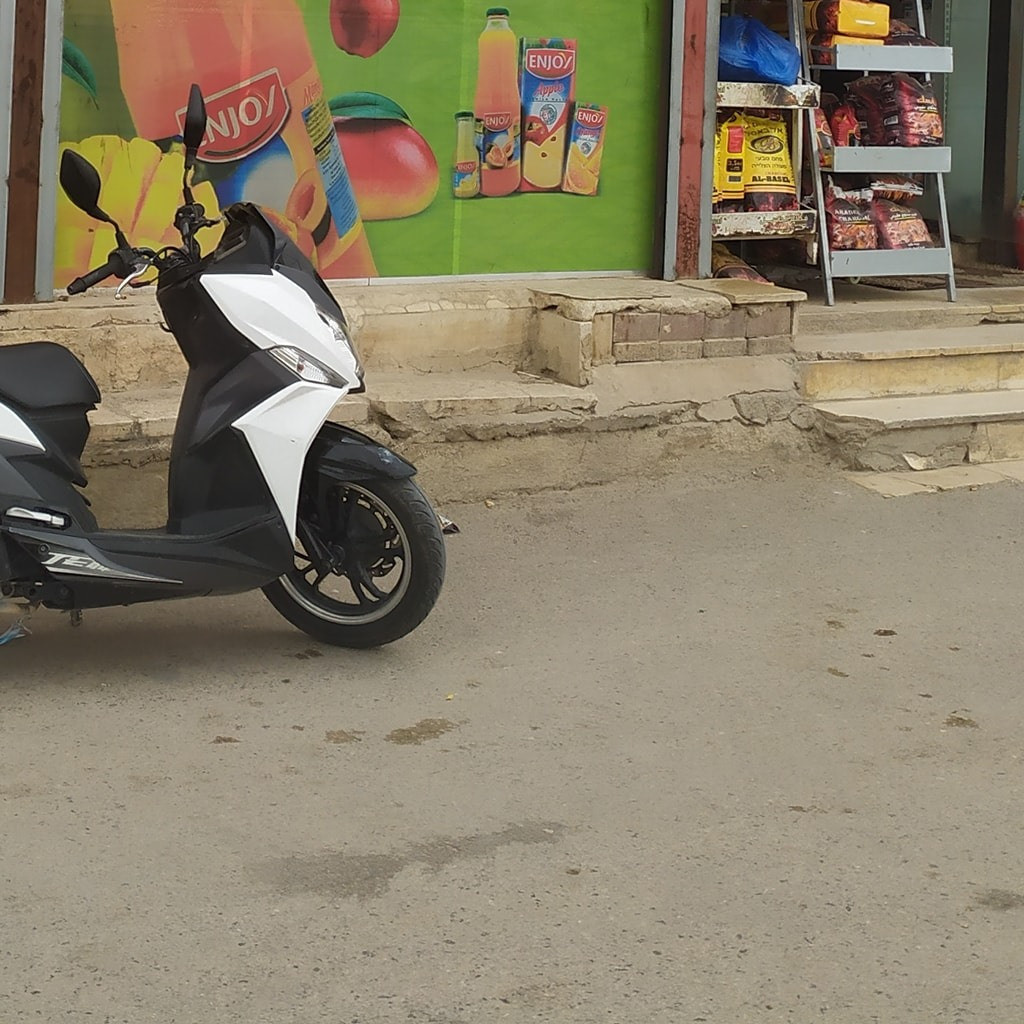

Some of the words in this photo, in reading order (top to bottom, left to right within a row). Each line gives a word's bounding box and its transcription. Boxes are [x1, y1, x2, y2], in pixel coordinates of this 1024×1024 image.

[528, 53, 573, 70] ENJOY
[198, 84, 276, 147] NJOY
[485, 115, 510, 126] ENJOY
[577, 110, 604, 123] ENJOY
